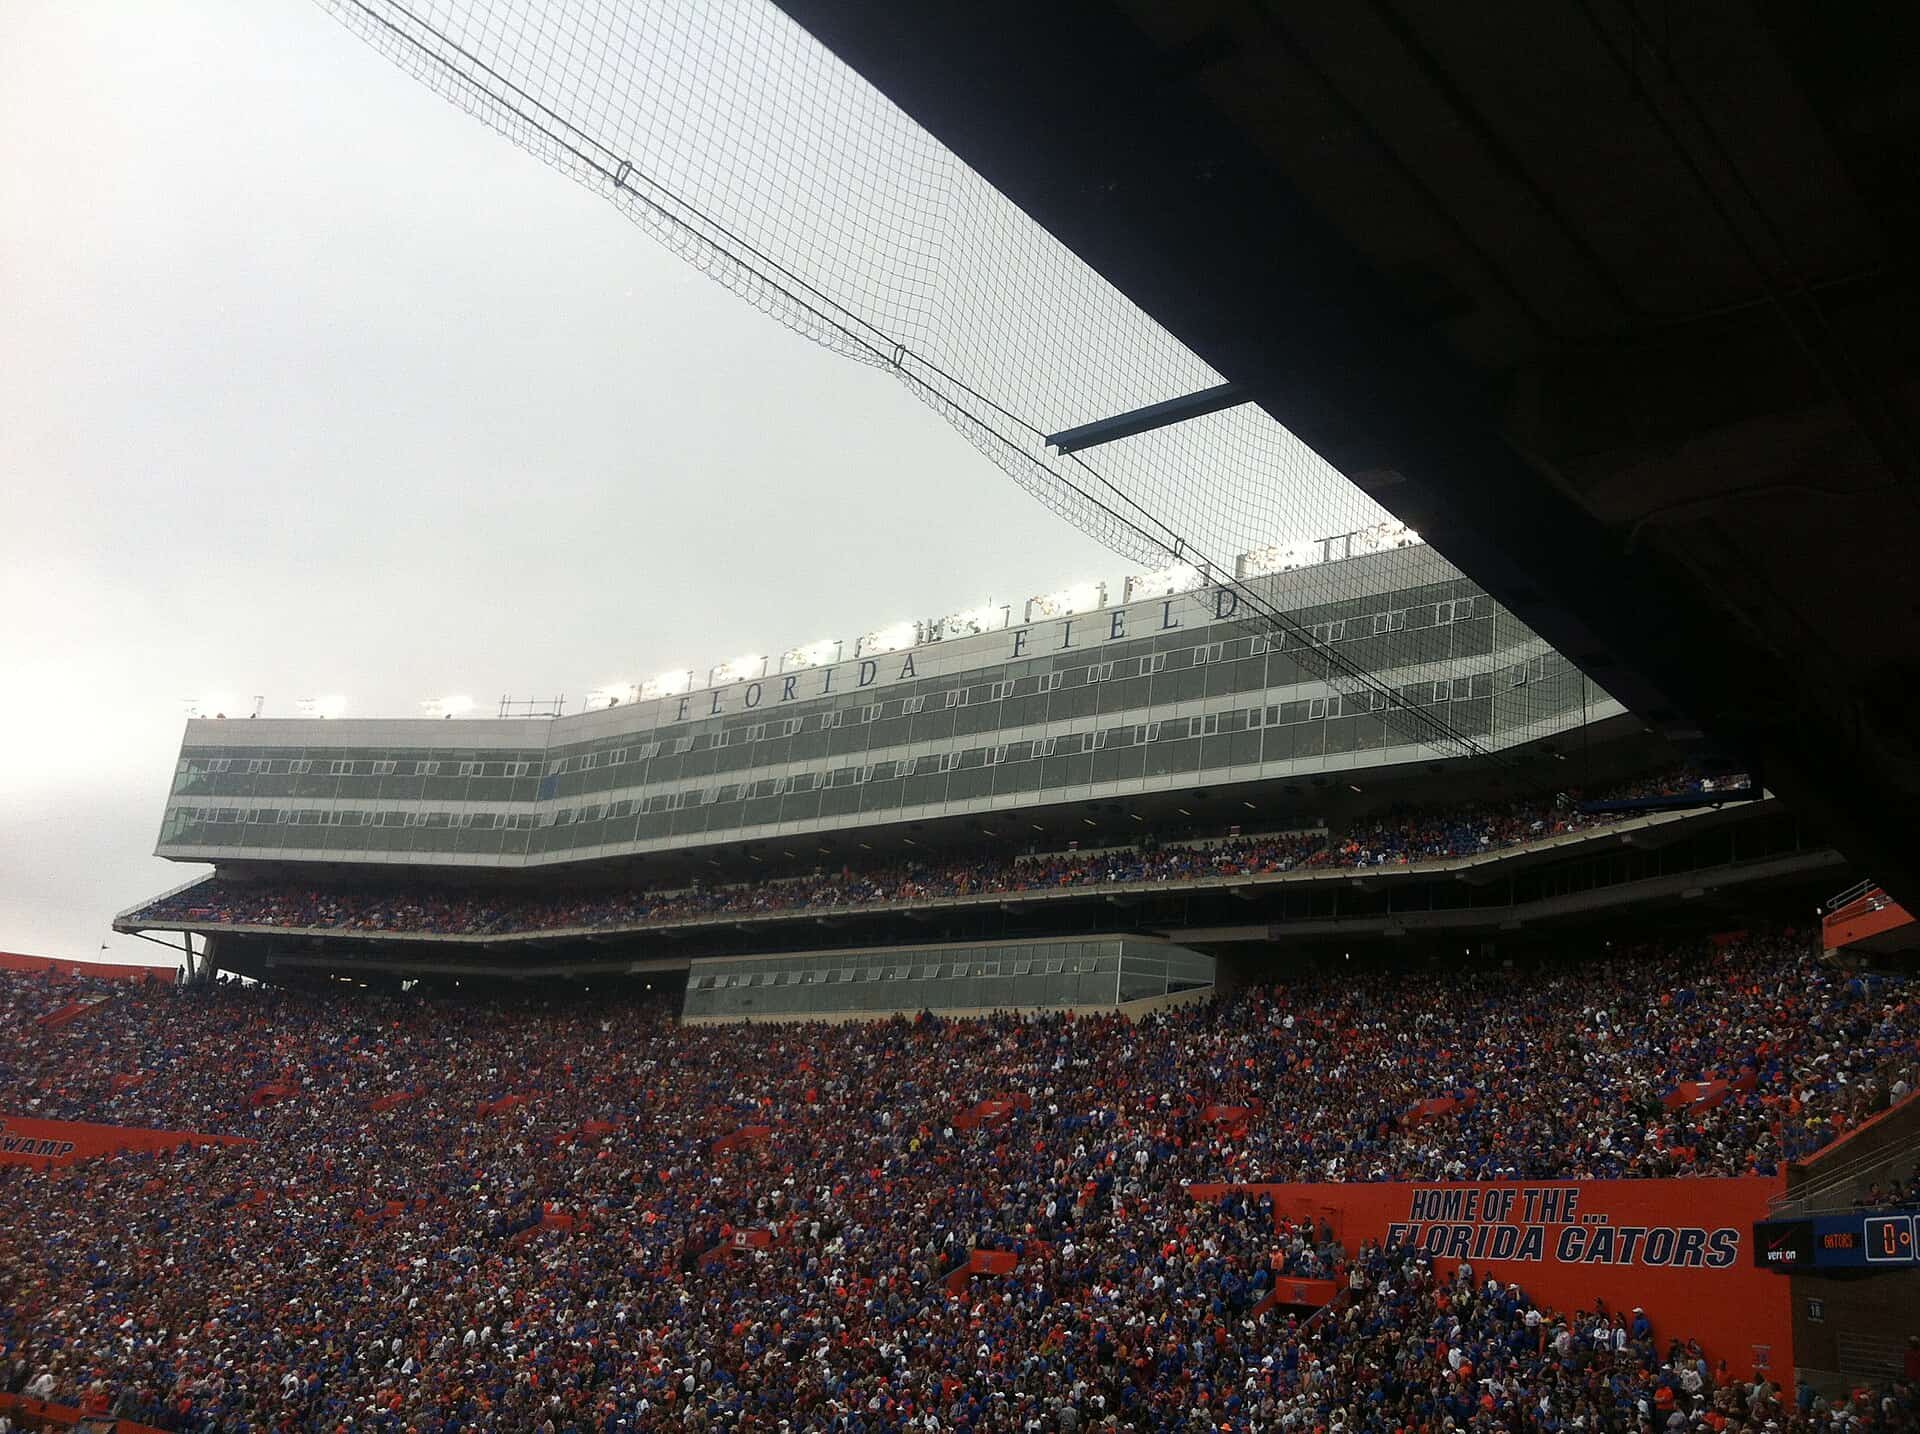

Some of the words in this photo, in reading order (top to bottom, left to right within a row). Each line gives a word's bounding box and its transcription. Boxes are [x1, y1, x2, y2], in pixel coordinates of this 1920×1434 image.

[676, 652, 917, 721] FLORIDA
[1011, 588, 1238, 658] FIELD
[0, 1136, 75, 1157] WAMP
[1408, 1188, 1476, 1222] HOME
[1482, 1188, 1516, 1222] OF
[1555, 1226, 1741, 1269] GATORS
